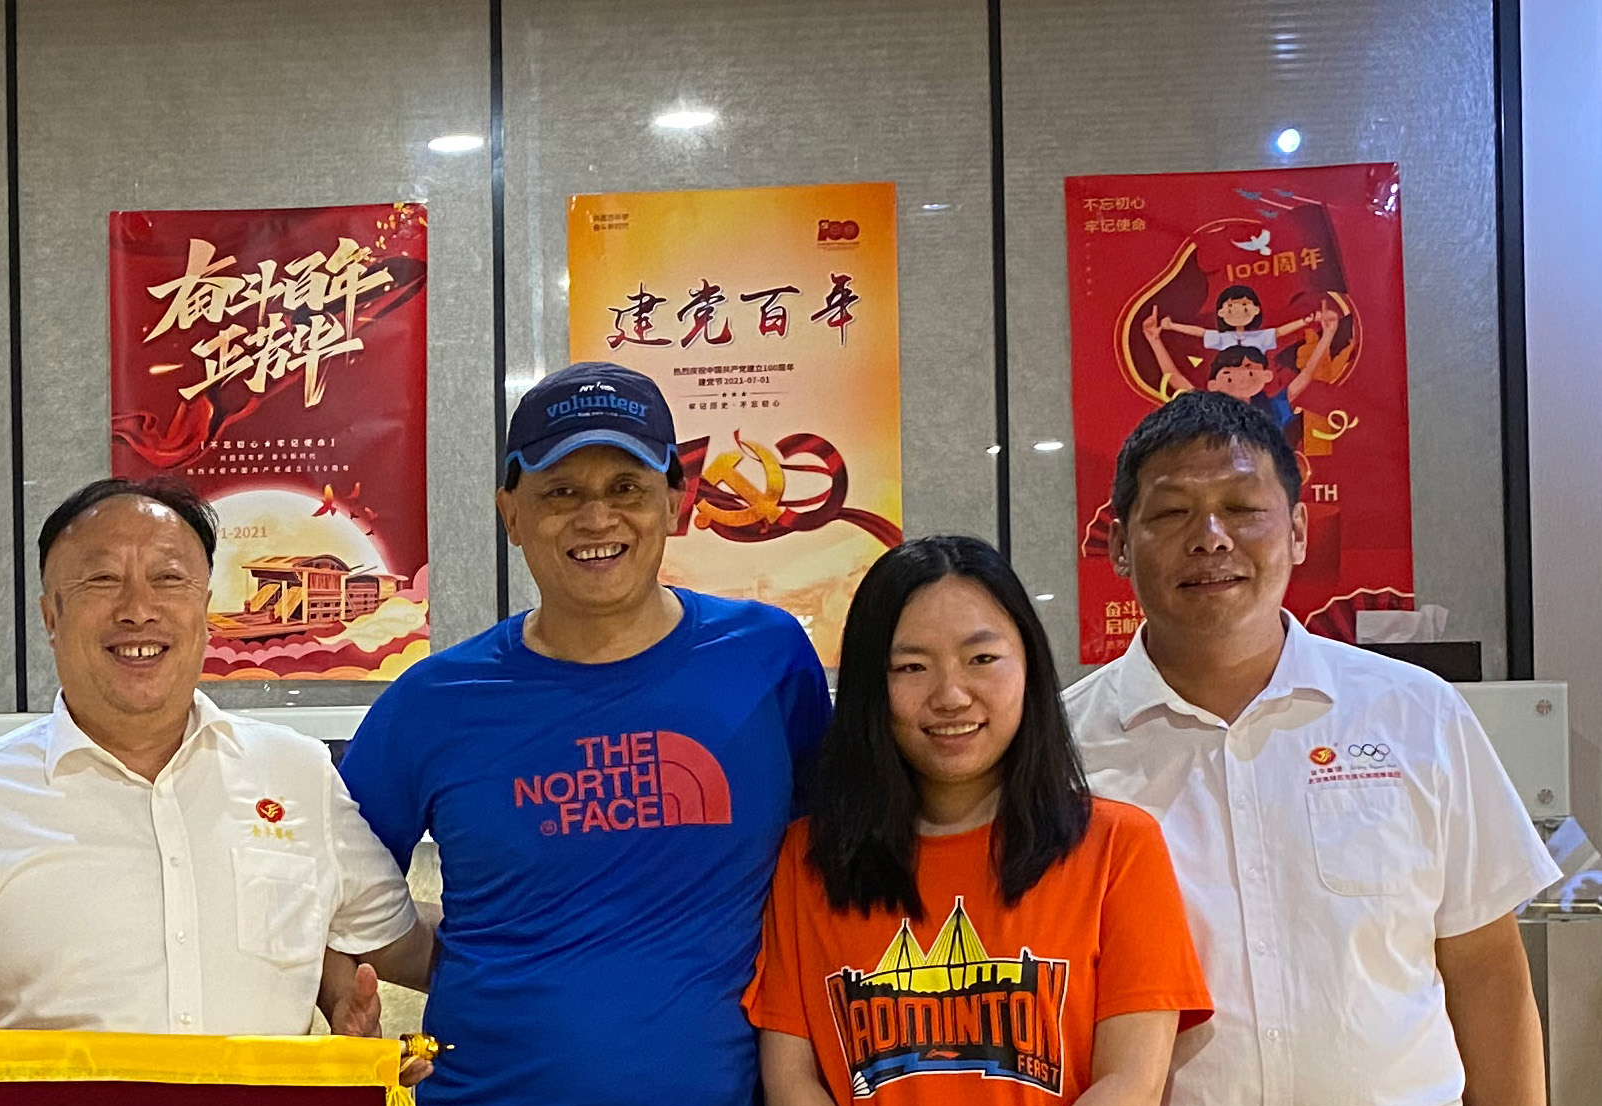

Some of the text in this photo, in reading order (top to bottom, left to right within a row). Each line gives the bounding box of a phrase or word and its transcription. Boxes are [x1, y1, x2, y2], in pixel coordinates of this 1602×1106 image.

[1083, 196, 1145, 211] 不忘初心
[1084, 218, 1146, 233] 牢记使命
[1226, 247, 1324, 281] 100周年
[143, 237, 394, 349] 奋斗百年
[605, 273, 860, 349] 建党百年
[179, 312, 365, 408] 正芳华
[546, 393, 649, 418] volunteer
[1311, 484, 1338, 502] TH
[575, 731, 655, 768] THE
[513, 763, 658, 808] NORTH
[560, 795, 662, 834] FACE
[1017, 1053, 1060, 1086] FEAST
